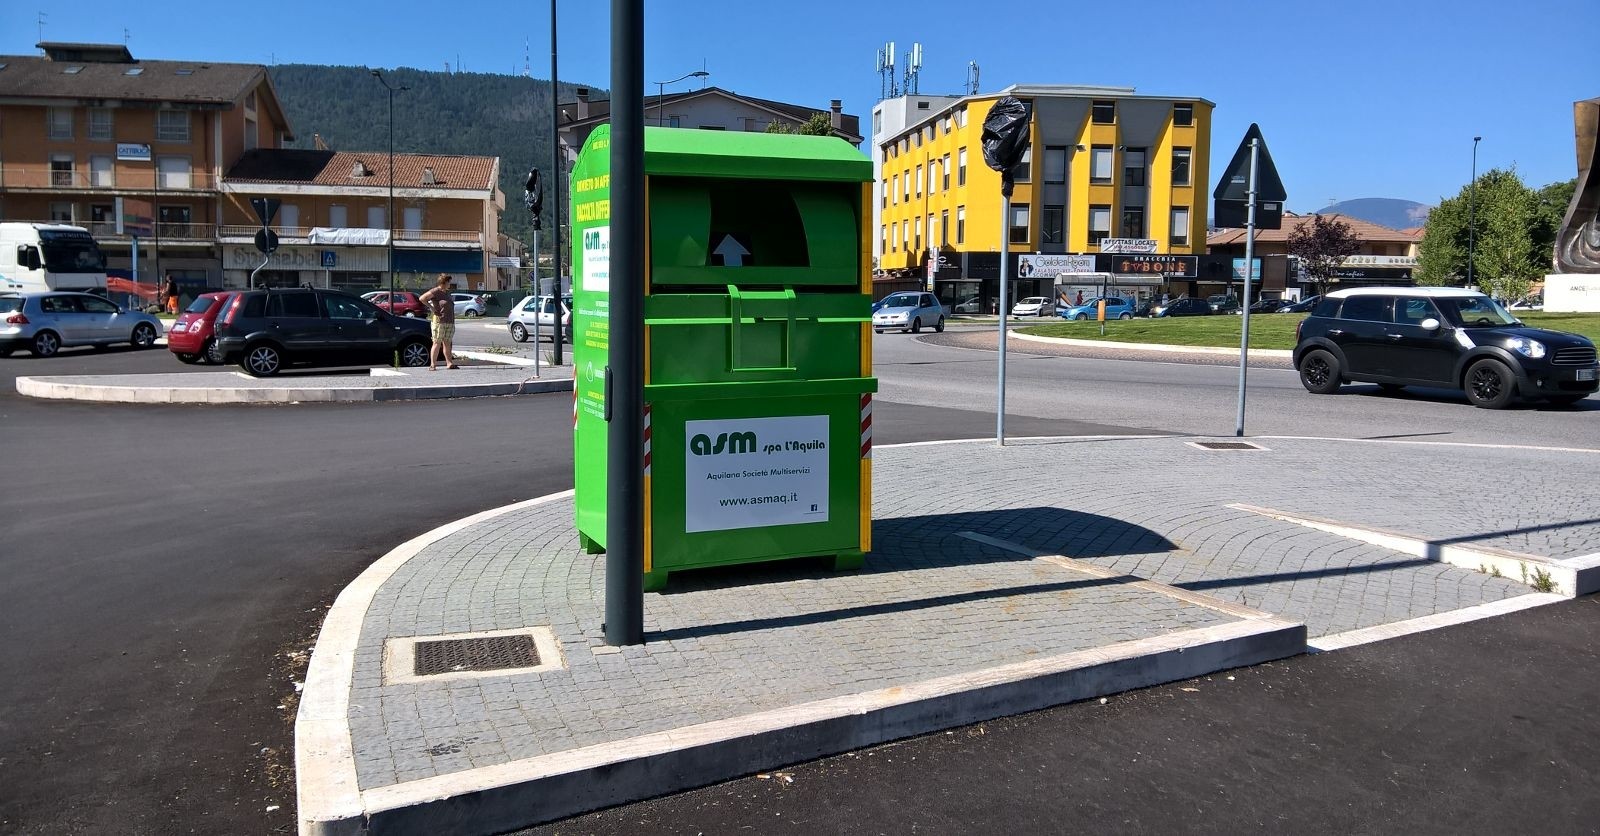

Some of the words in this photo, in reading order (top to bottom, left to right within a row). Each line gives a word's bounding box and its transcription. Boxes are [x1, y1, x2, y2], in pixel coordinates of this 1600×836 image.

[690, 431, 757, 456] asm
[763, 443, 782, 454] spa
[706, 472, 741, 481] Aquilana
[770, 466, 811, 476] Multiservizi
[719, 492, 798, 507] www.asmaq.it
